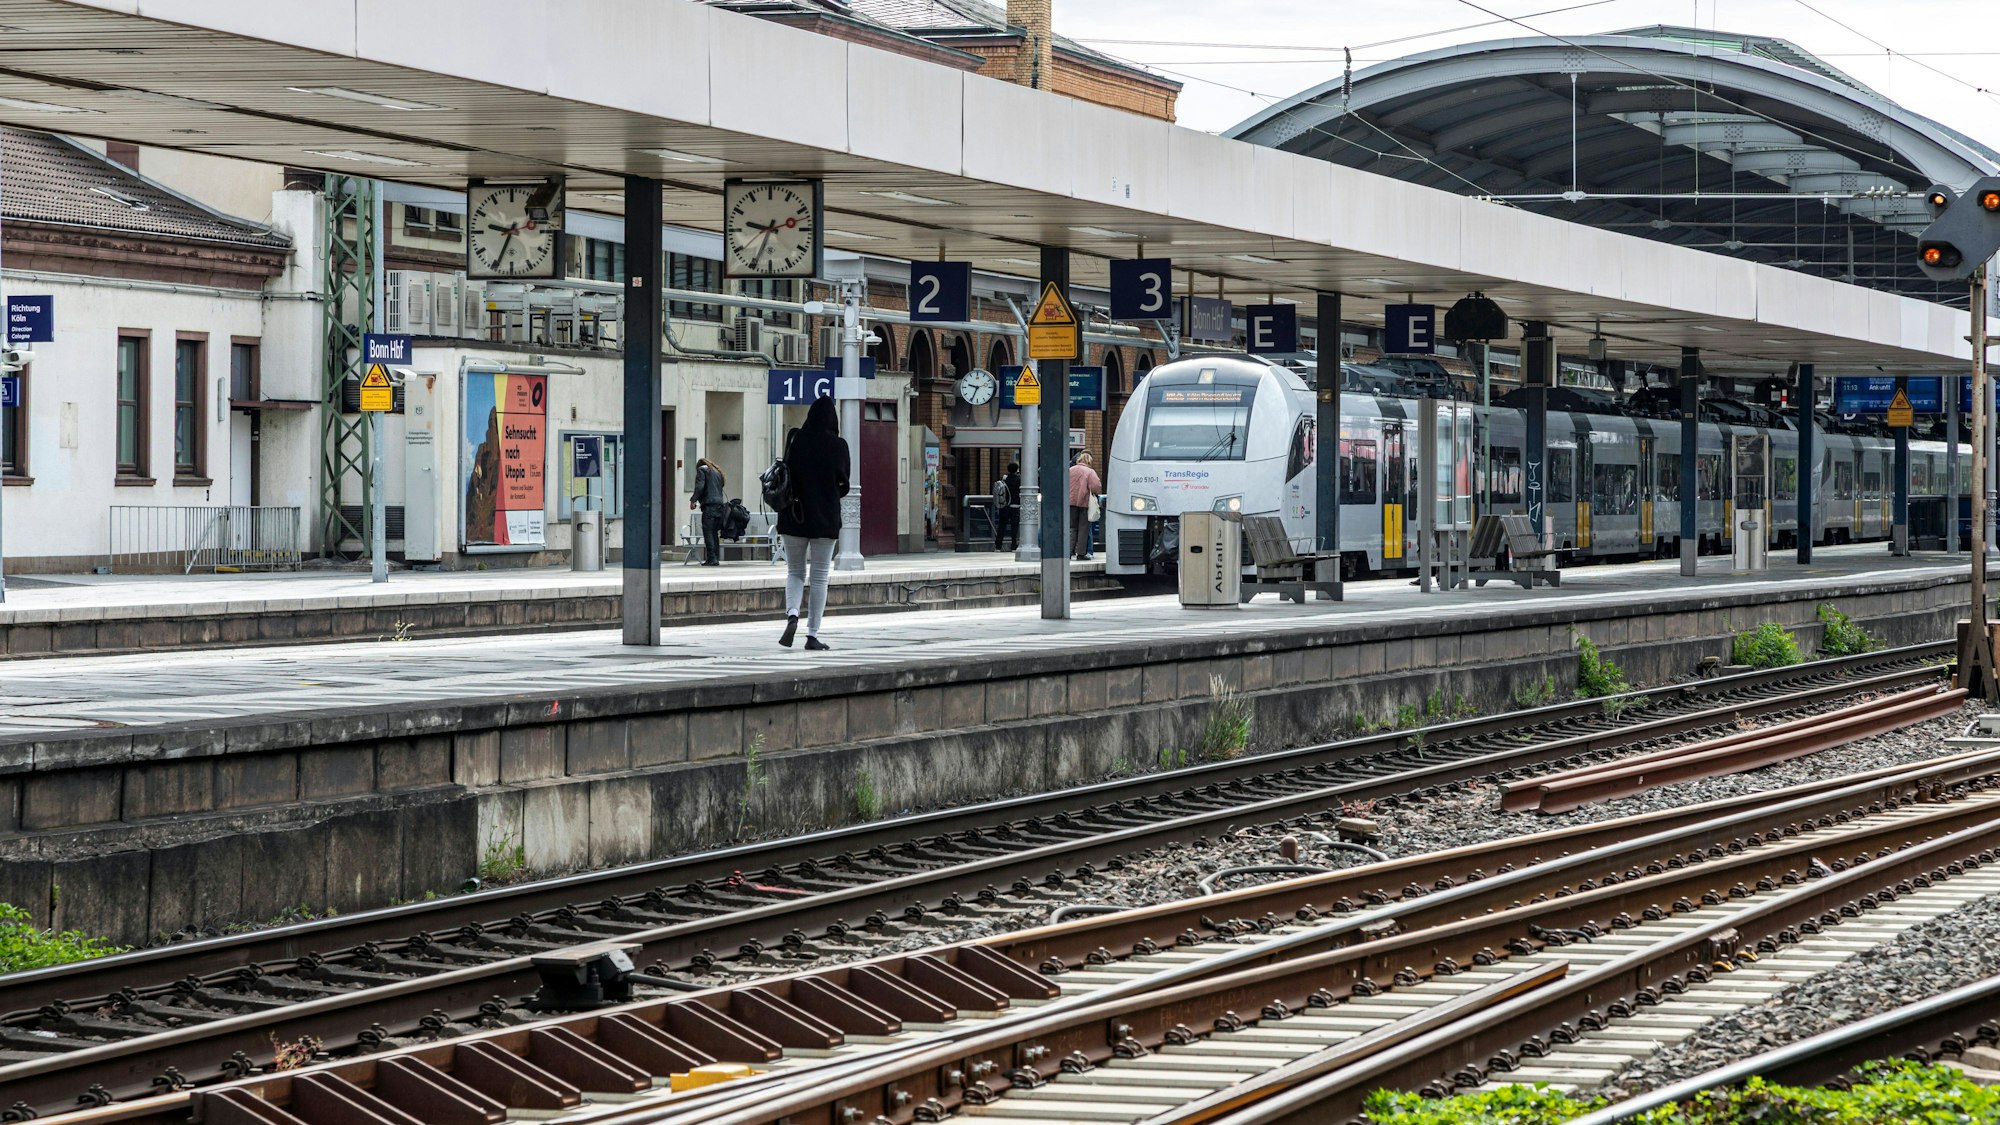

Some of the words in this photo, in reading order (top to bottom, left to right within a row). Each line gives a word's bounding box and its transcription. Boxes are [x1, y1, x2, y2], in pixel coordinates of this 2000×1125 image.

[918, 274, 940, 313] 2
[1139, 272, 1164, 312] 3
[11, 304, 41, 313] Richtung
[11, 313, 27, 322] Köln
[1193, 304, 1211, 329] Bonn
[1212, 306, 1224, 331] Hbf
[1254, 316, 1275, 348] E
[1408, 316, 1428, 347] E
[369, 339, 389, 358] Bonn
[390, 339, 404, 359] Hbf
[783, 377, 796, 400] 1
[814, 377, 831, 399] G
[505, 424, 537, 440] Sehnsucht
[505, 444, 520, 459] nach
[505, 463, 526, 482] Utopia
[1164, 470, 1209, 479] TransRegio
[1215, 543, 1223, 593] Abfall
